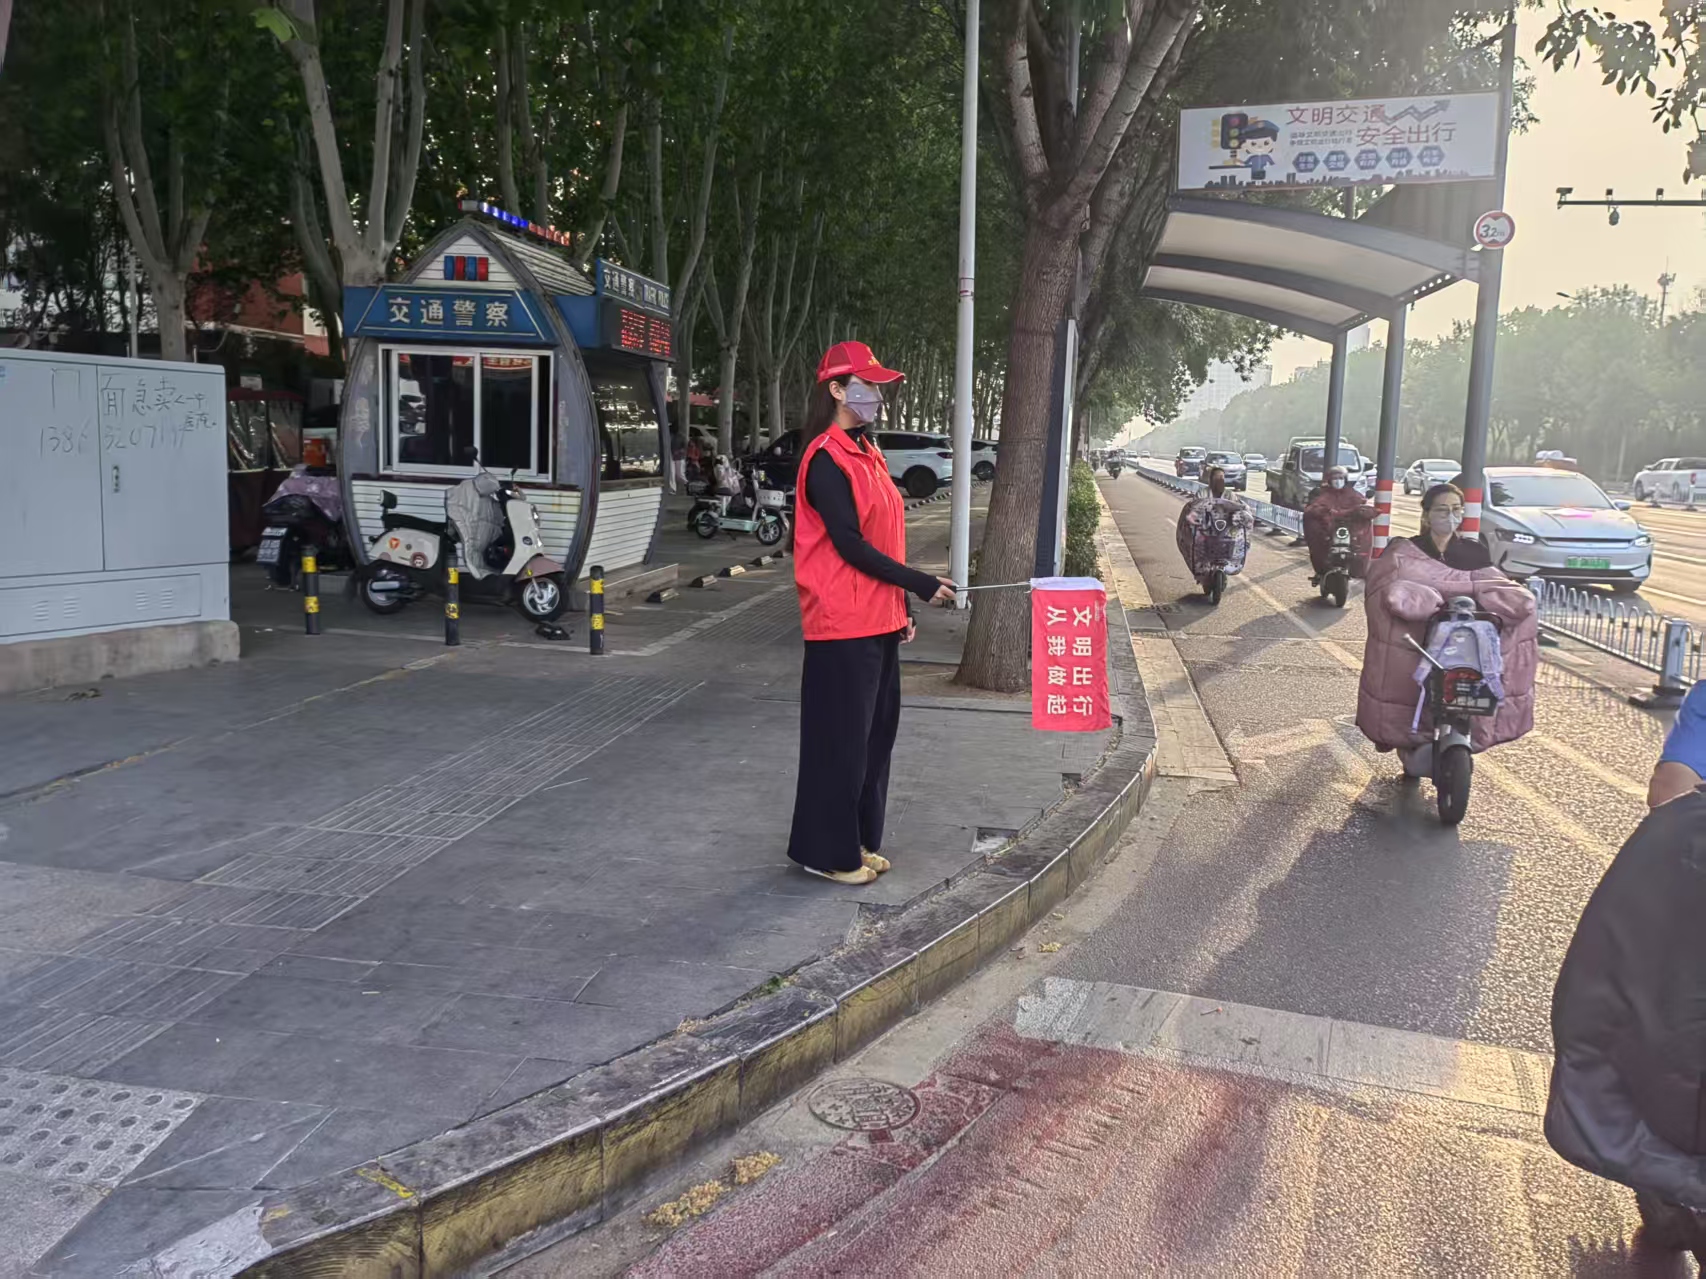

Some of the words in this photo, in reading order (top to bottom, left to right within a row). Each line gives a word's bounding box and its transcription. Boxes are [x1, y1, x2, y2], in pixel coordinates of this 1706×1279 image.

[1286, 104, 1386, 126] 文明交通
[1356, 121, 1457, 147] 安全出行
[388, 297, 509, 329] 交通警察
[1047, 605, 1067, 716] 从我做起
[1073, 606, 1093, 717] 文明出行
